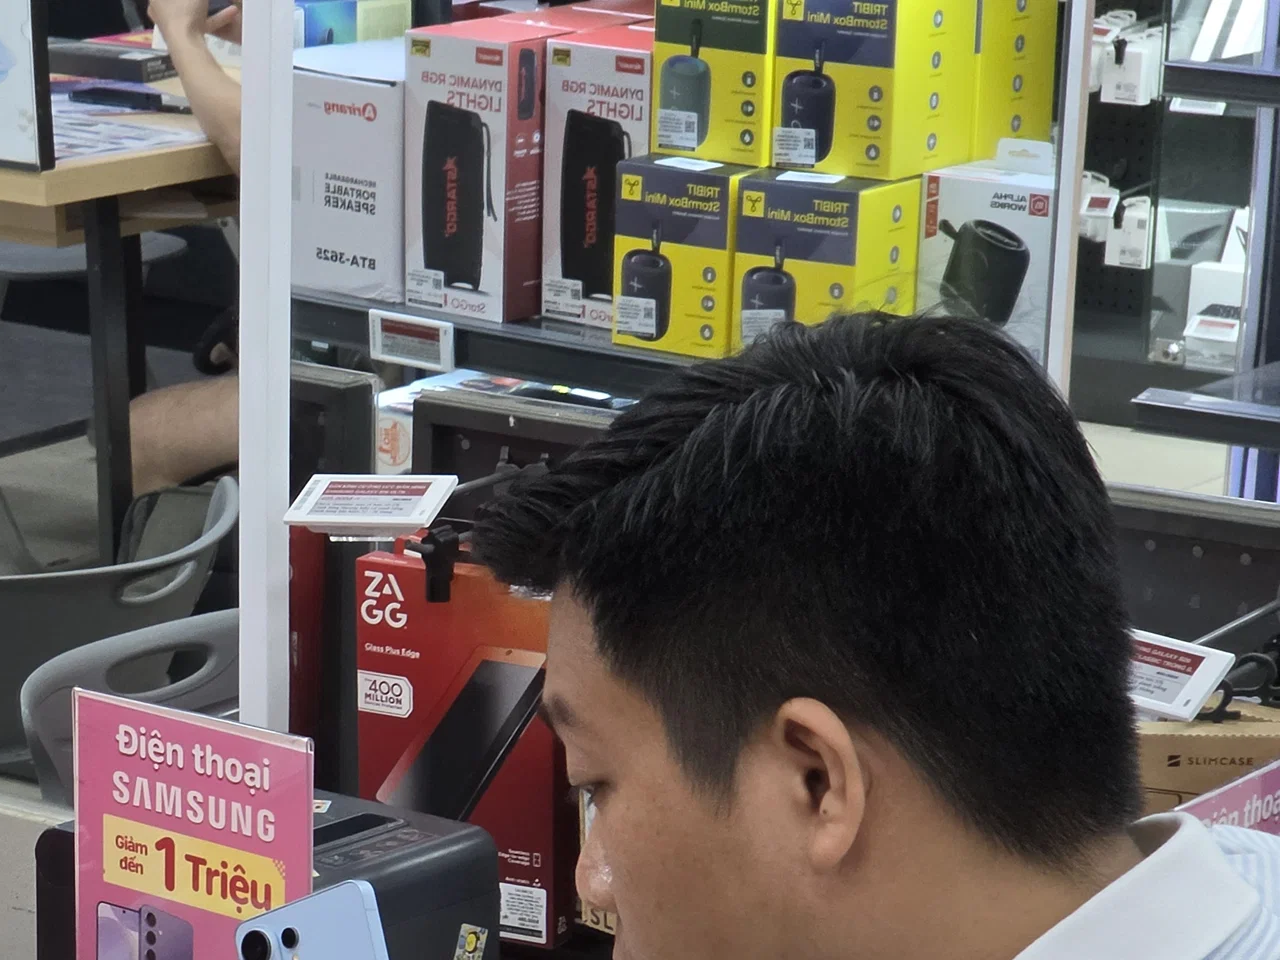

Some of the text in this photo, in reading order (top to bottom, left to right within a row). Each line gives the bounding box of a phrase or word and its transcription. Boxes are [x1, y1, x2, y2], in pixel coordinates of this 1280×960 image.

[365, 642, 420, 659] Glass Plus Edge
[369, 679, 403, 698] 400
[365, 692, 402, 705] MILLION
[115, 724, 270, 795] Điện thoại
[1187, 757, 1254, 766] SLIMCASE
[112, 771, 276, 842] SAMSUNG
[115, 835, 148, 856] Giảm
[120, 856, 144, 875] đến
[155, 837, 272, 913] 1 Triệu
